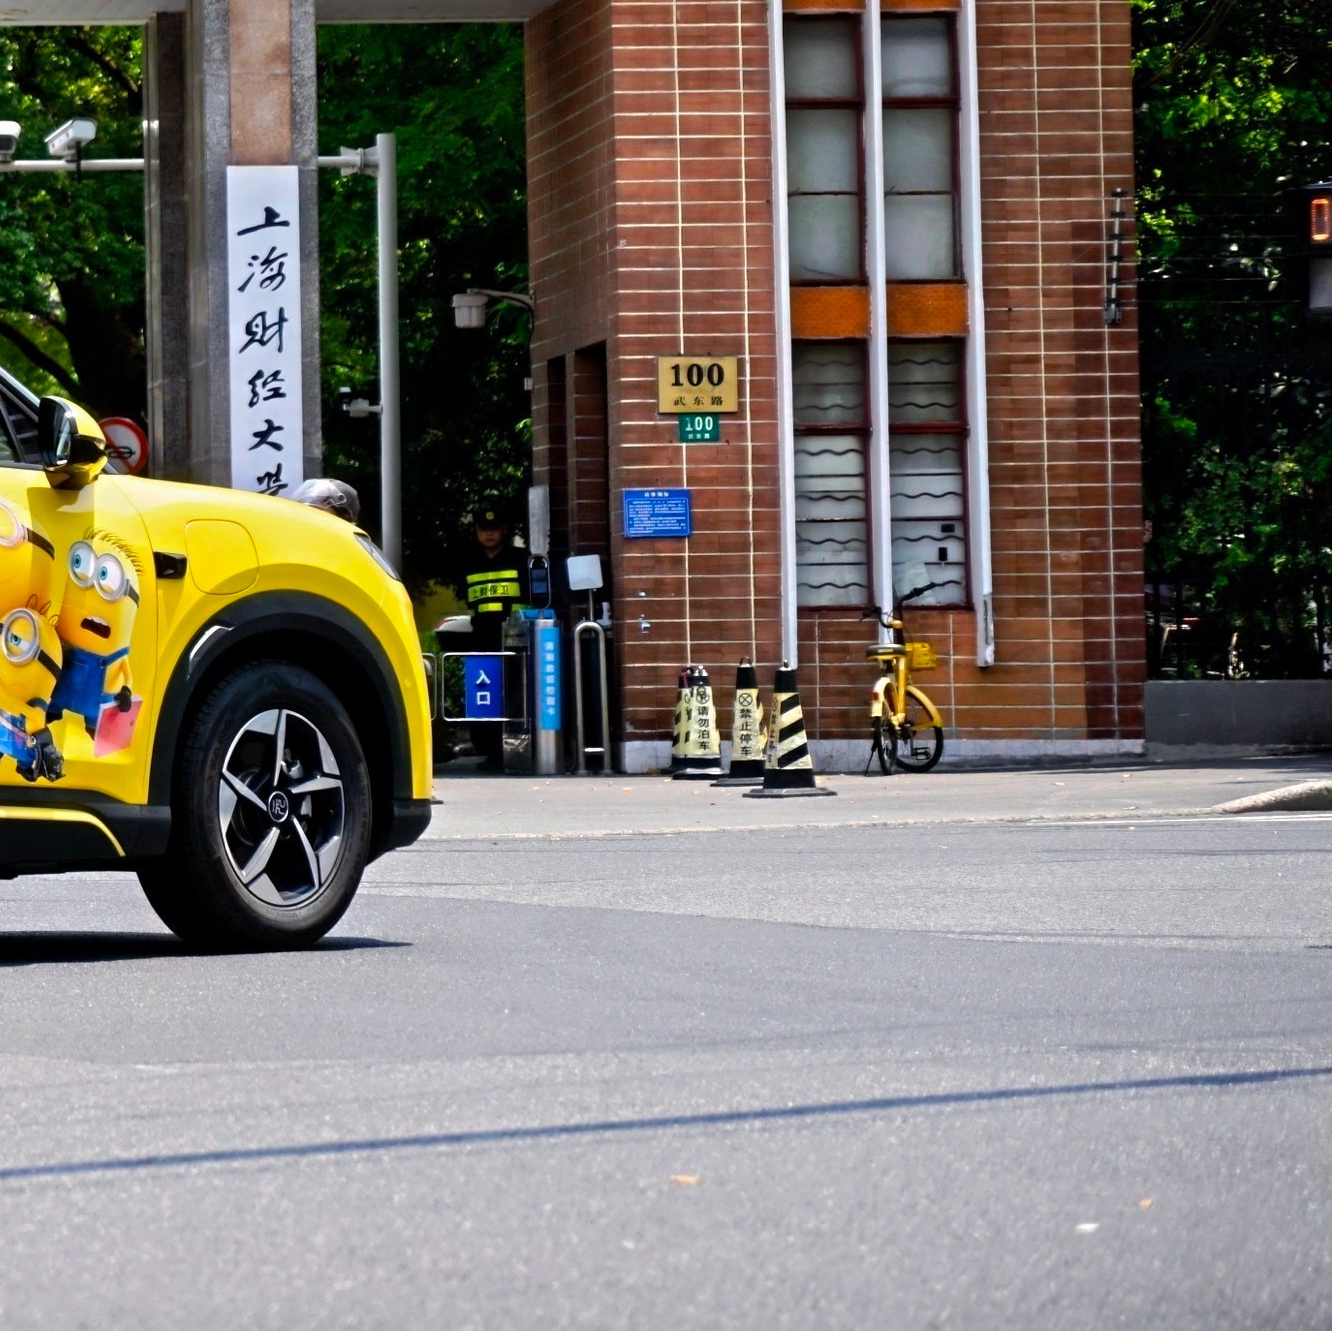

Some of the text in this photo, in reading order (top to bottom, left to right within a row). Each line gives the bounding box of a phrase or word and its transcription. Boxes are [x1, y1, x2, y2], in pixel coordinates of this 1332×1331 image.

[671, 363, 725, 387] 100
[674, 396, 723, 406] 武东路
[685, 416, 713, 431] 100
[476, 670, 491, 706] 入口
[697, 706, 710, 751] 请勿泊车
[739, 708, 753, 756] 禁止停车
